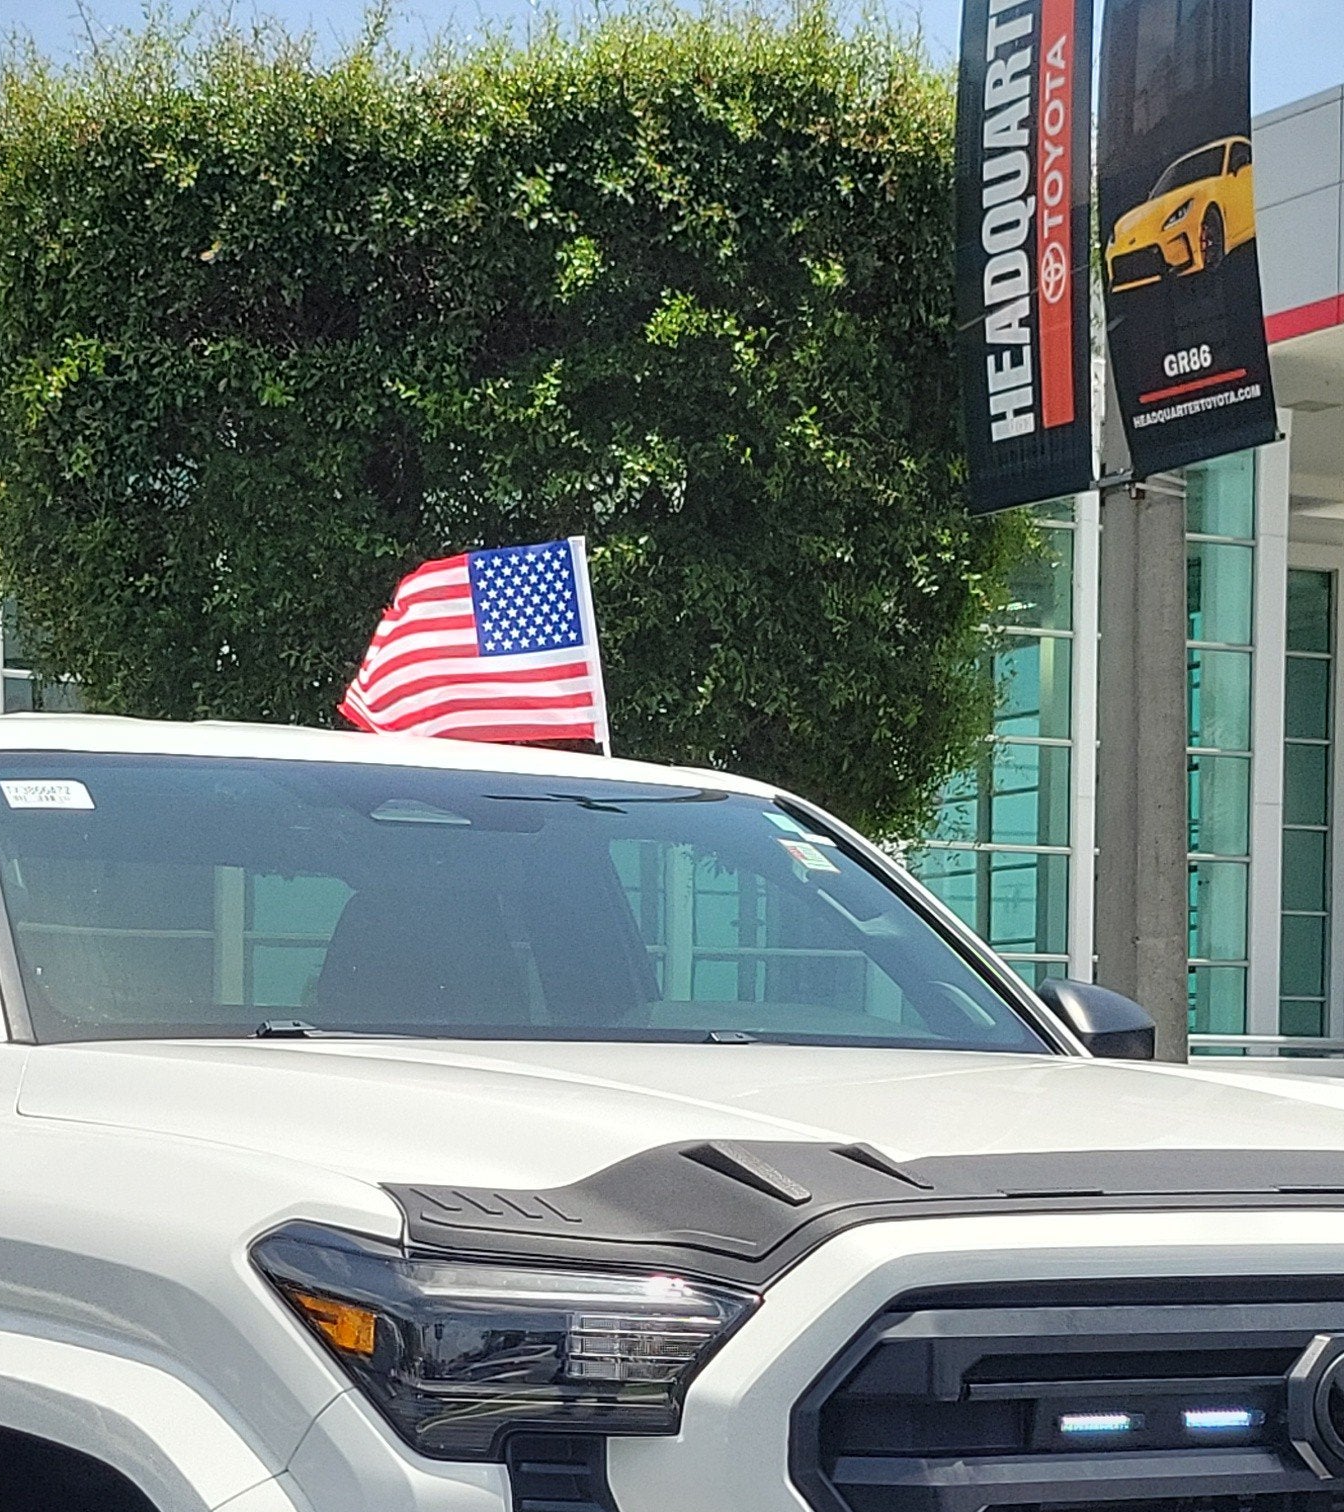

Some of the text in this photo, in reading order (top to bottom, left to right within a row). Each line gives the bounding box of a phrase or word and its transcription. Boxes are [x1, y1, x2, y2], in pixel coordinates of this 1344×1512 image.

[1043, 34, 1067, 238] TOYOTA
[1163, 344, 1212, 377] GR86
[1133, 384, 1261, 429] HEADQUARTERTOYOTA.COM
